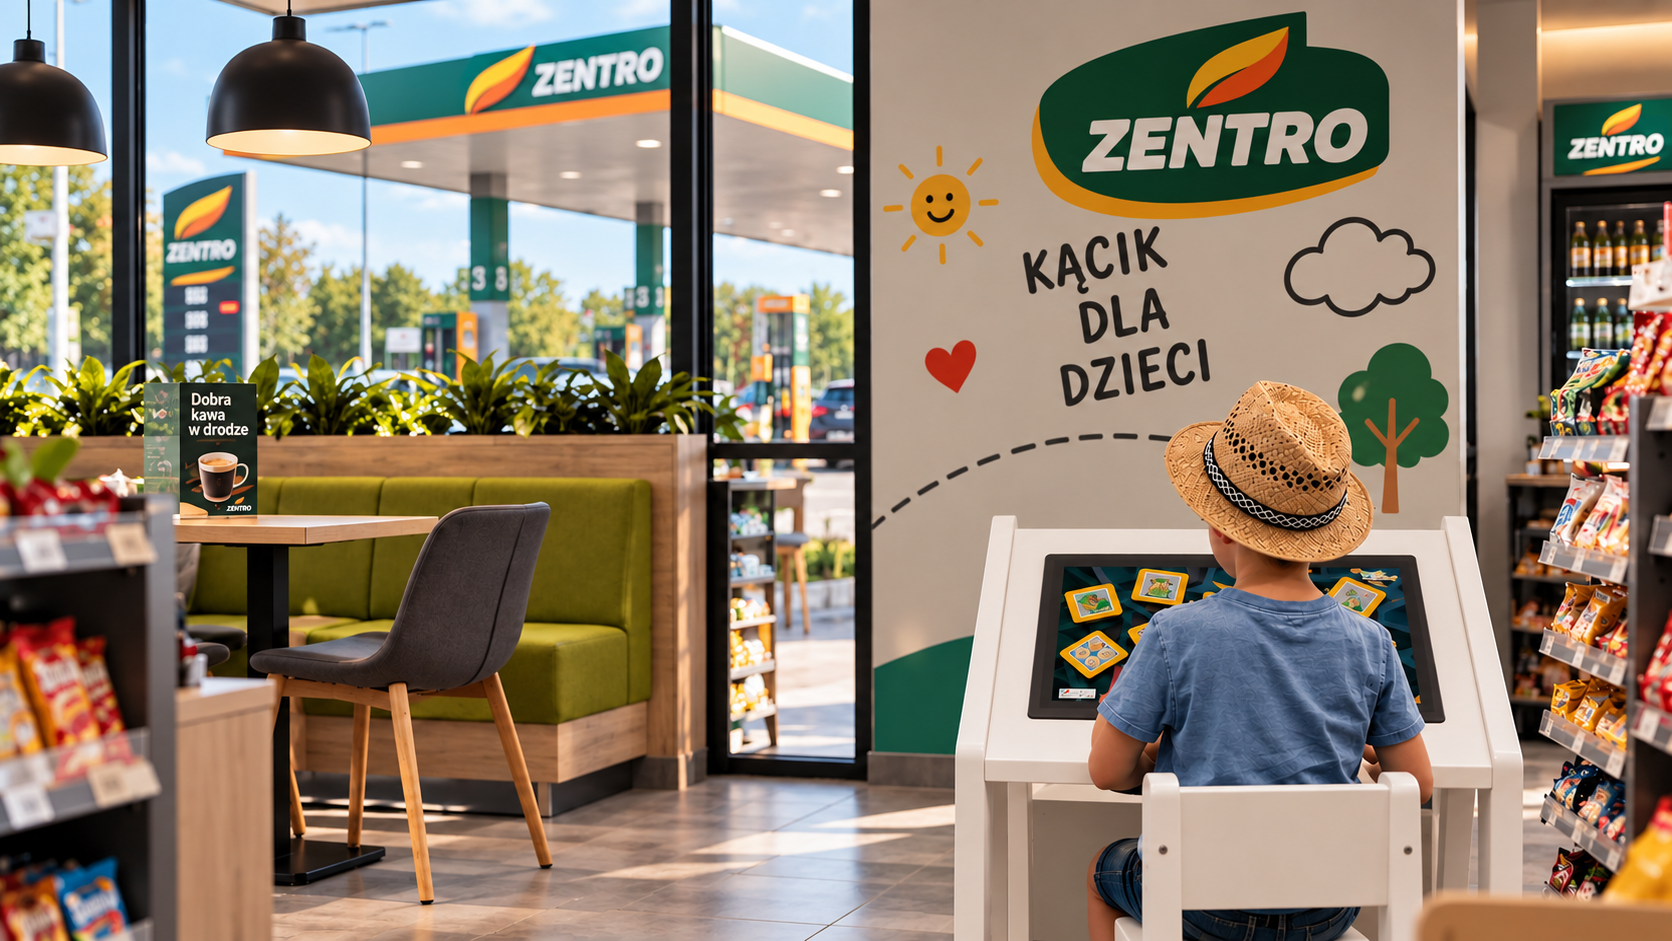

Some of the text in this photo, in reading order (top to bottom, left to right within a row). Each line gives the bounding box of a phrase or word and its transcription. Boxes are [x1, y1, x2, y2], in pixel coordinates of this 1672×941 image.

[531, 47, 664, 97] ZENTRO
[1081, 108, 1368, 173] ZENTRO
[1567, 133, 1665, 160] ZENTRO
[165, 239, 237, 263] ZENTRO
[1023, 226, 1168, 294] KĄCIK
[1078, 287, 1170, 344] DLA
[1060, 338, 1211, 407] DZIECI
[191, 392, 232, 406] Dobra
[191, 408, 226, 421] kawa
[188, 422, 249, 436] w drodze
